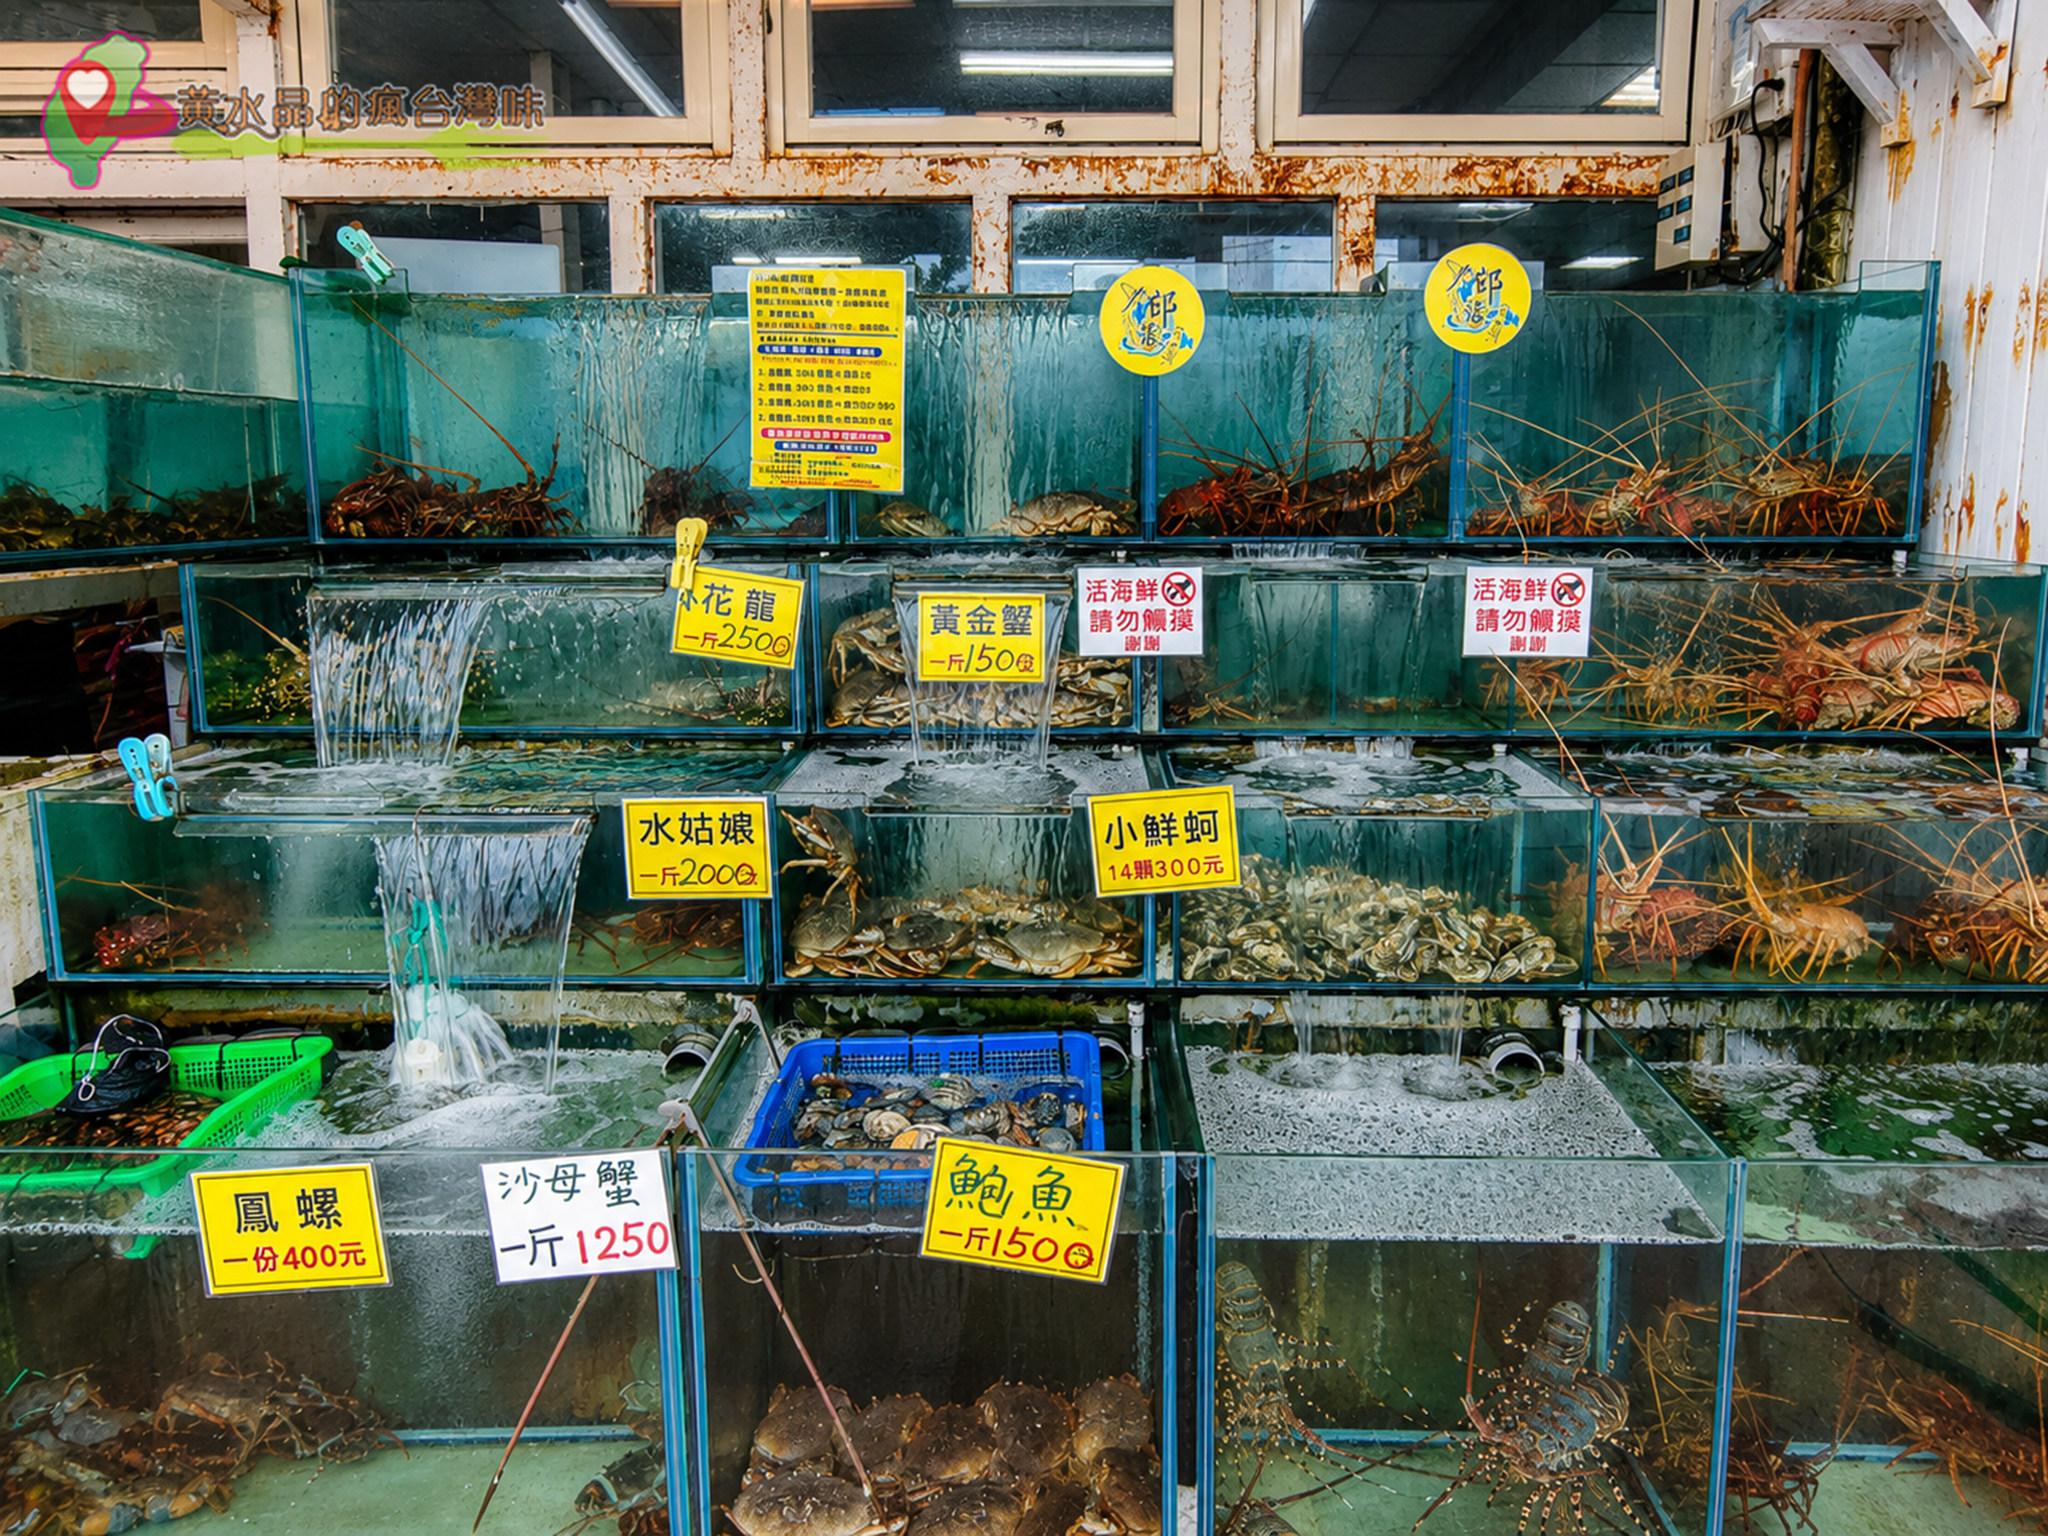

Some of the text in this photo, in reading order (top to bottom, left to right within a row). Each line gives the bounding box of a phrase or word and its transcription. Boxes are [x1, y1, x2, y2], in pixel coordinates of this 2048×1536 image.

[1086, 578, 1159, 603] 活海鮮
[1473, 577, 1548, 602] 活海鮮
[930, 604, 1033, 636] 黃金蟹
[639, 811, 755, 846] 水姑娘
[1105, 810, 1219, 850] 小鮮蚵
[1108, 855, 1224, 881] 14顆300元
[498, 1159, 640, 1208] 沙母蟹
[945, 1153, 1076, 1228] 鮑魚
[234, 1187, 343, 1234] 鳳螺
[223, 1242, 367, 1274] 一份400元
